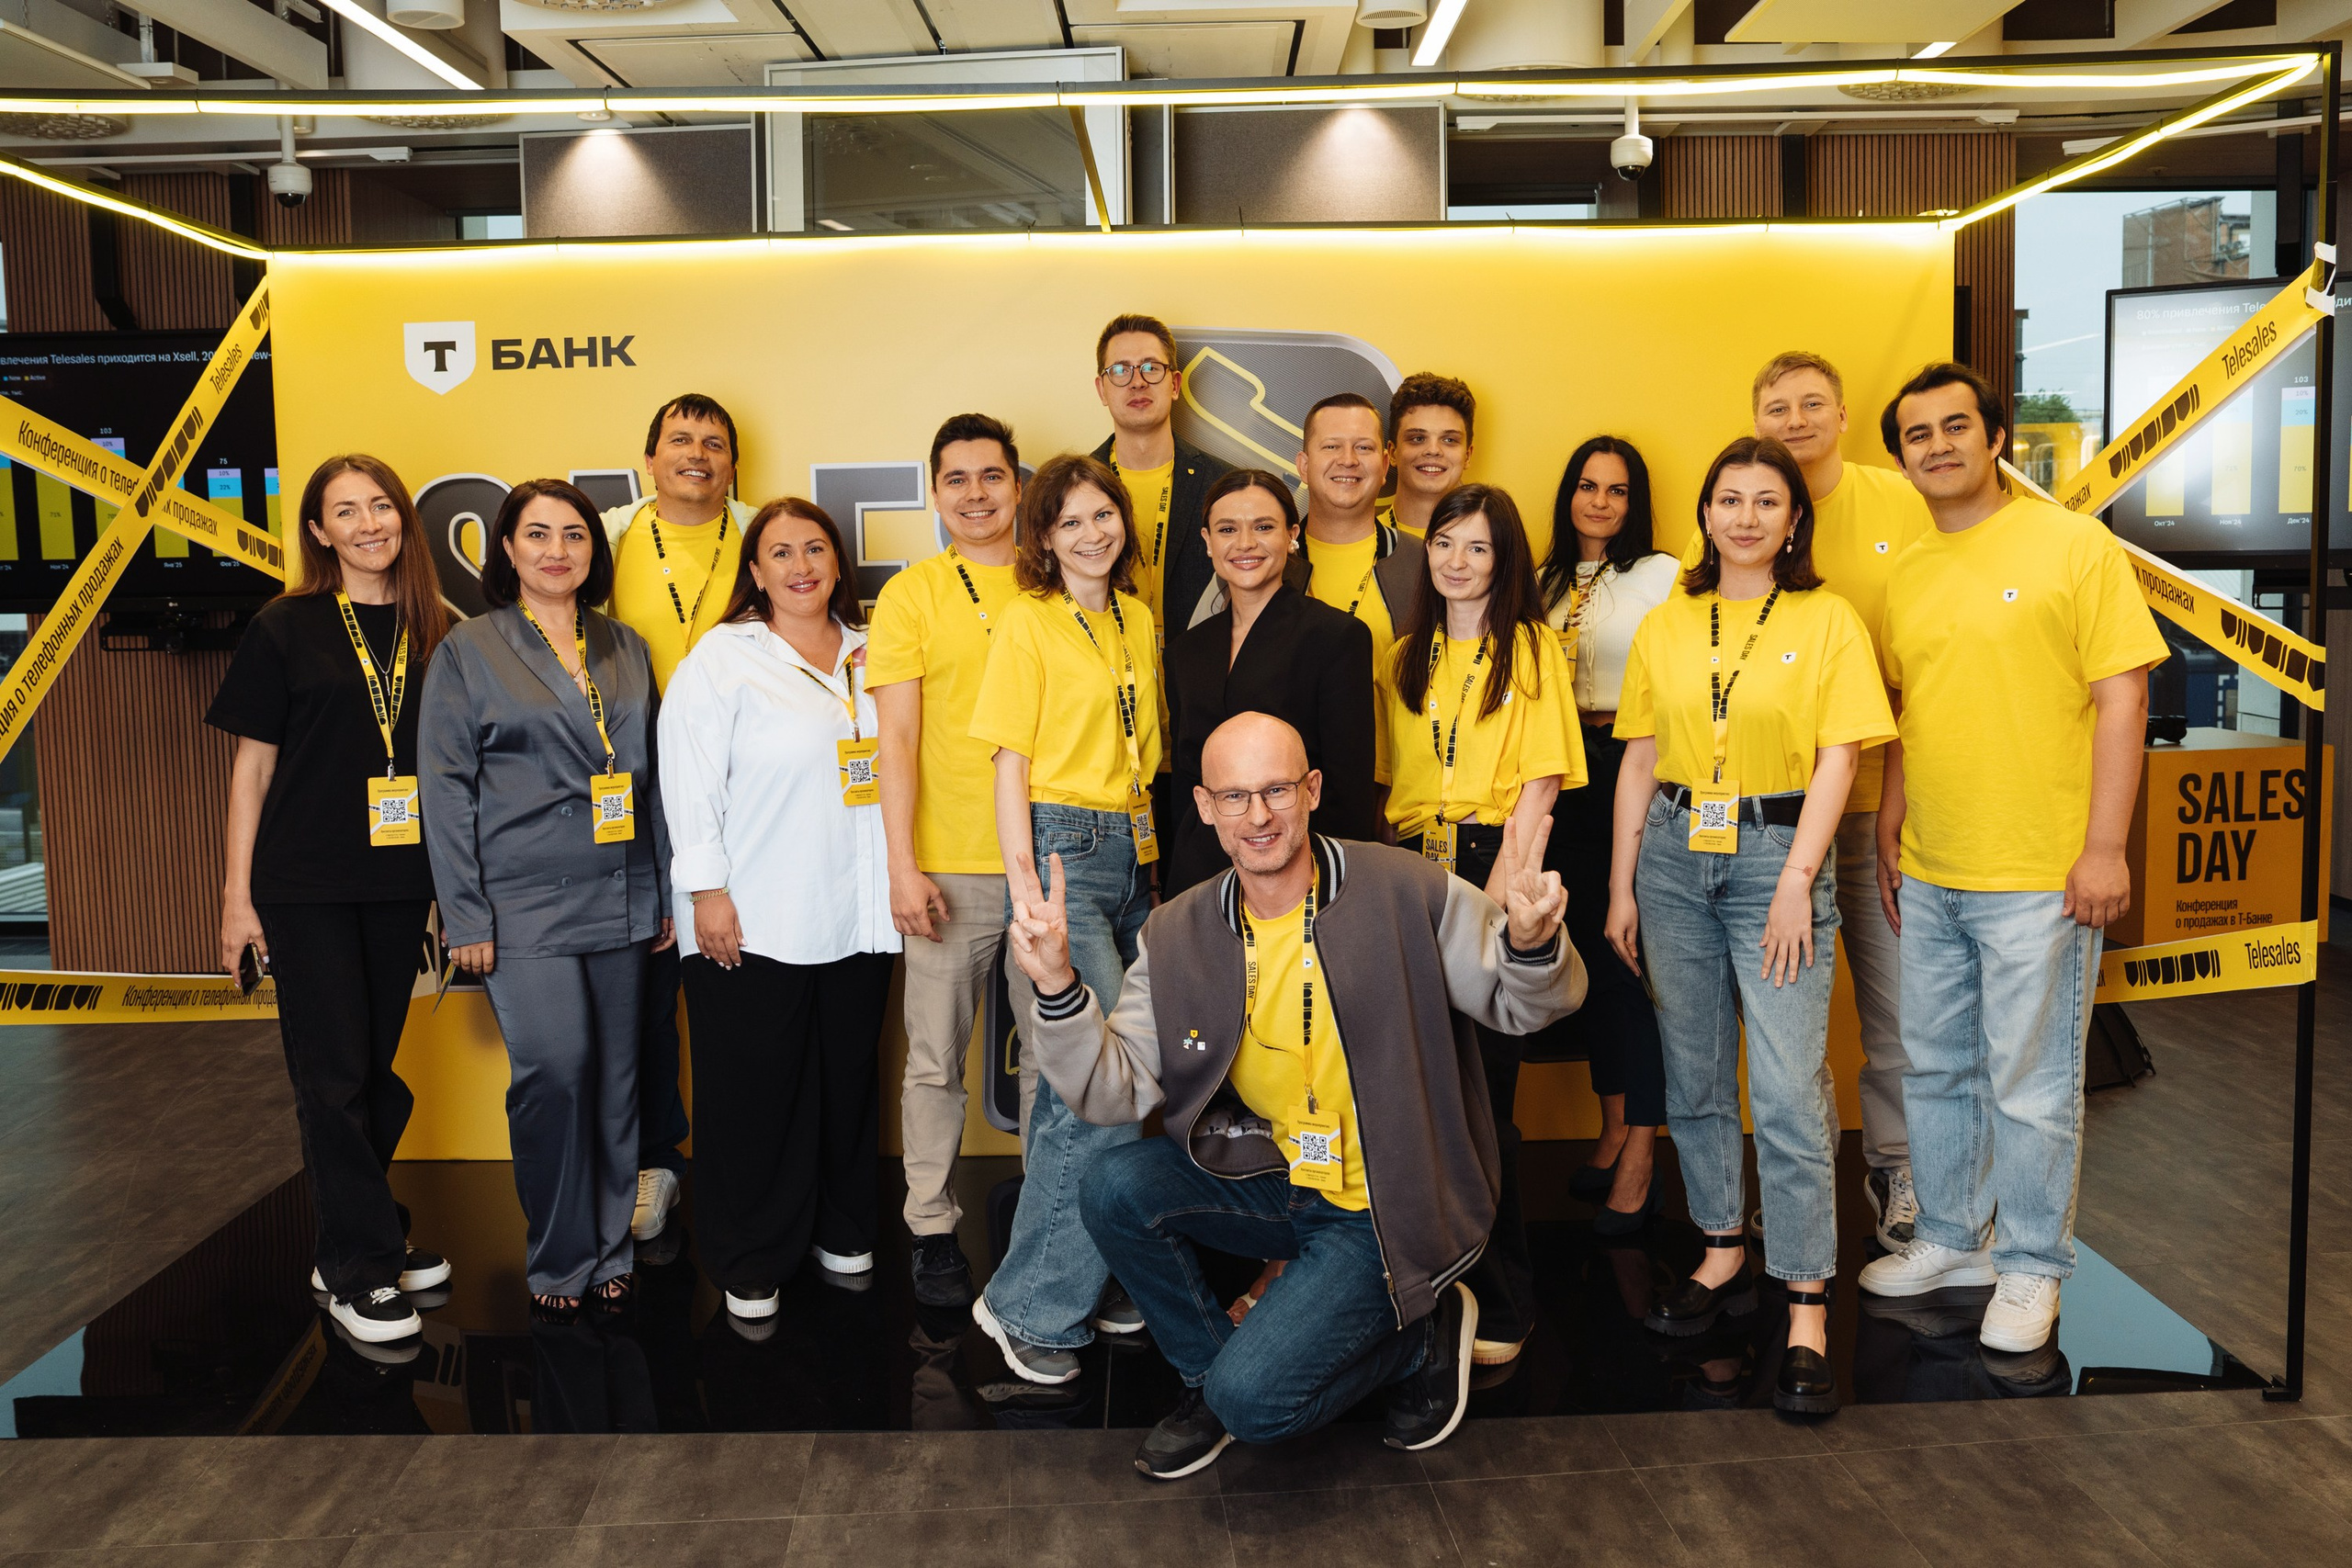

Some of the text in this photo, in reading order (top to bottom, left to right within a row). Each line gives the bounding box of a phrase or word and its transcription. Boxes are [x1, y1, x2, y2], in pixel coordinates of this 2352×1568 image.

[2137, 310, 2160, 321] 80%
[2162, 306, 2240, 319] привлечения
[50, 354, 96, 365] Telesales
[97, 354, 156, 365] приходится
[158, 354, 171, 362] на
[173, 351, 199, 362] Xsell,
[492, 335, 637, 370] БАНК
[2222, 321, 2278, 380] Telesales
[209, 343, 243, 395] Telesales
[18, 420, 98, 480] Конференция
[100, 466, 107, 484] о
[173, 501, 219, 537] продажах
[2141, 569, 2195, 615] продажах
[15, 688, 26, 705] о
[21, 599, 84, 694] телефонных
[78, 536, 124, 608] продажах
[1744, 634, 1758, 650] SALES
[1463, 673, 1476, 693] SALES
[2177, 769, 2307, 825] SALES
[1426, 838, 1448, 853] SALES
[2177, 829, 2257, 884] DAY
[2176, 899, 2238, 914] Конференция
[2176, 912, 2273, 931] о продажах в Т-Банке
[2245, 936, 2301, 970] Telesales
[1248, 961, 1256, 984] SALES
[121, 985, 192, 1012] Конференция
[192, 989, 199, 1006] о
